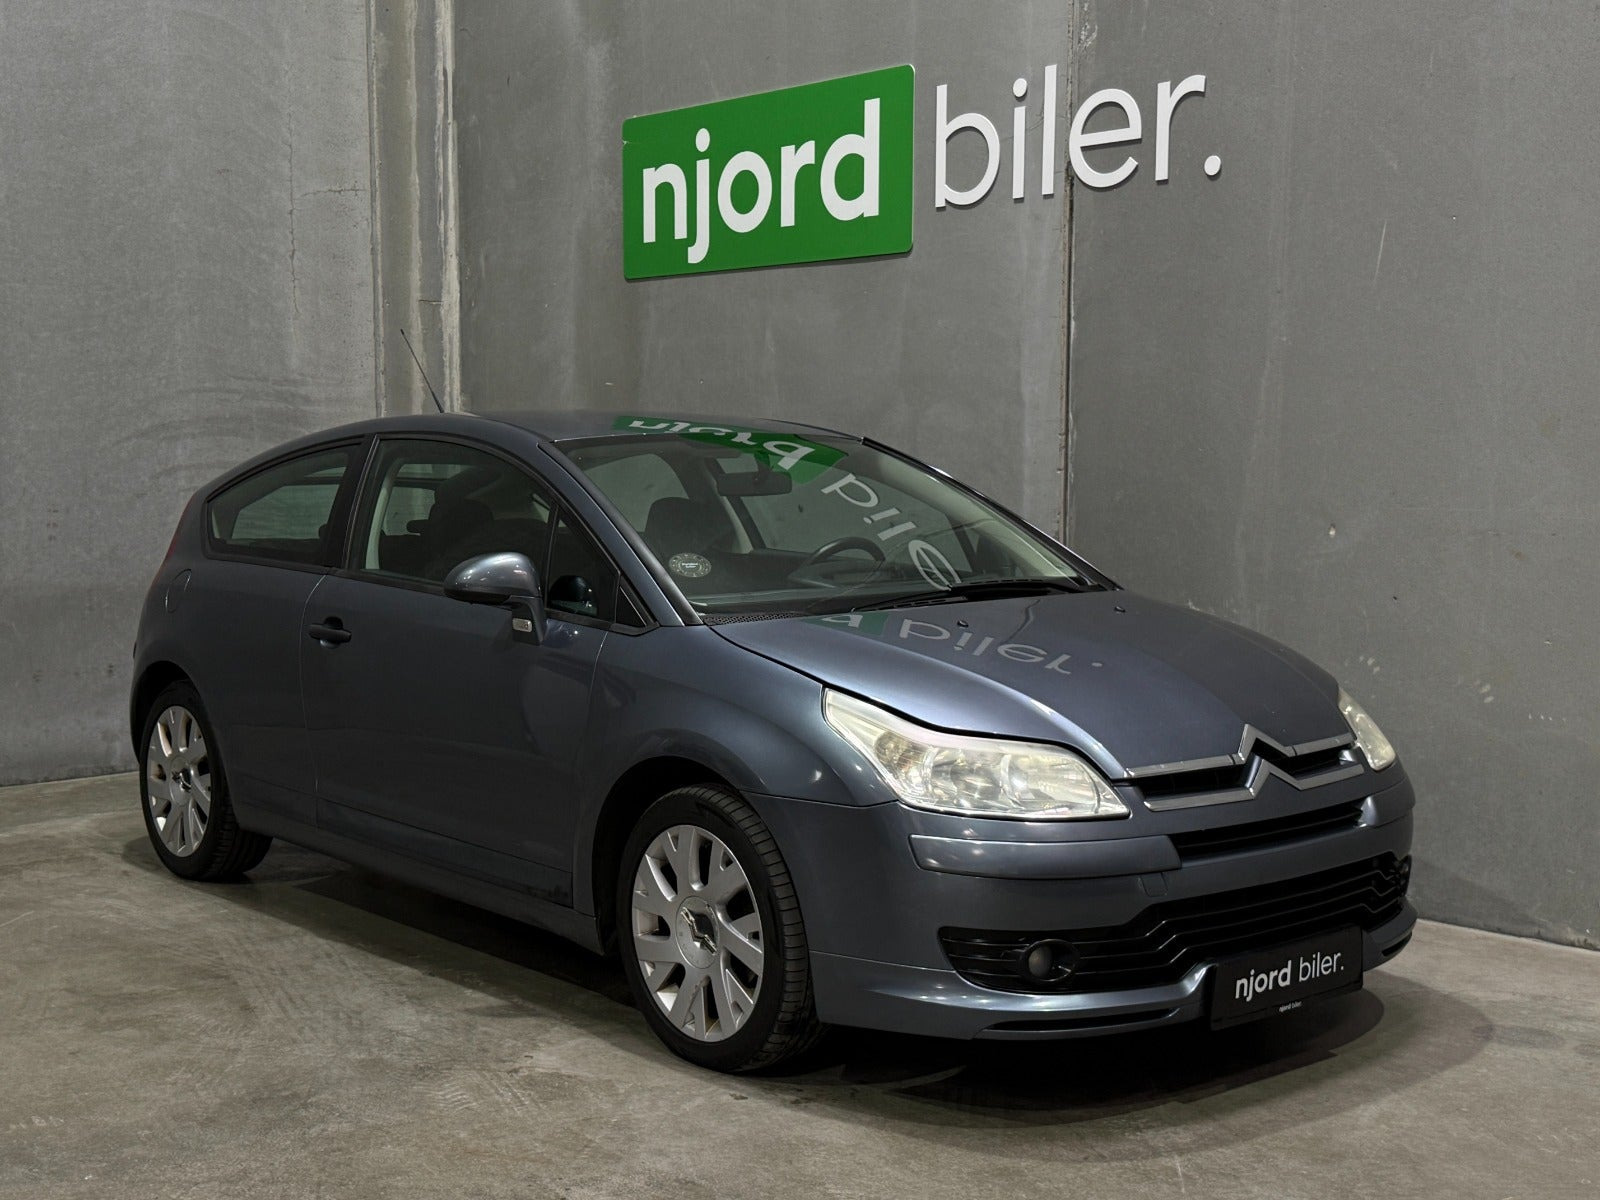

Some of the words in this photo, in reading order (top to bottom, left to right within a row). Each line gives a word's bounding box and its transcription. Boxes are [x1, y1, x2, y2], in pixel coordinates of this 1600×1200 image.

[642, 97, 881, 264] njord
[934, 63, 1222, 209] biler.
[1235, 959, 1292, 1002] njord
[1298, 951, 1344, 982] biler.
